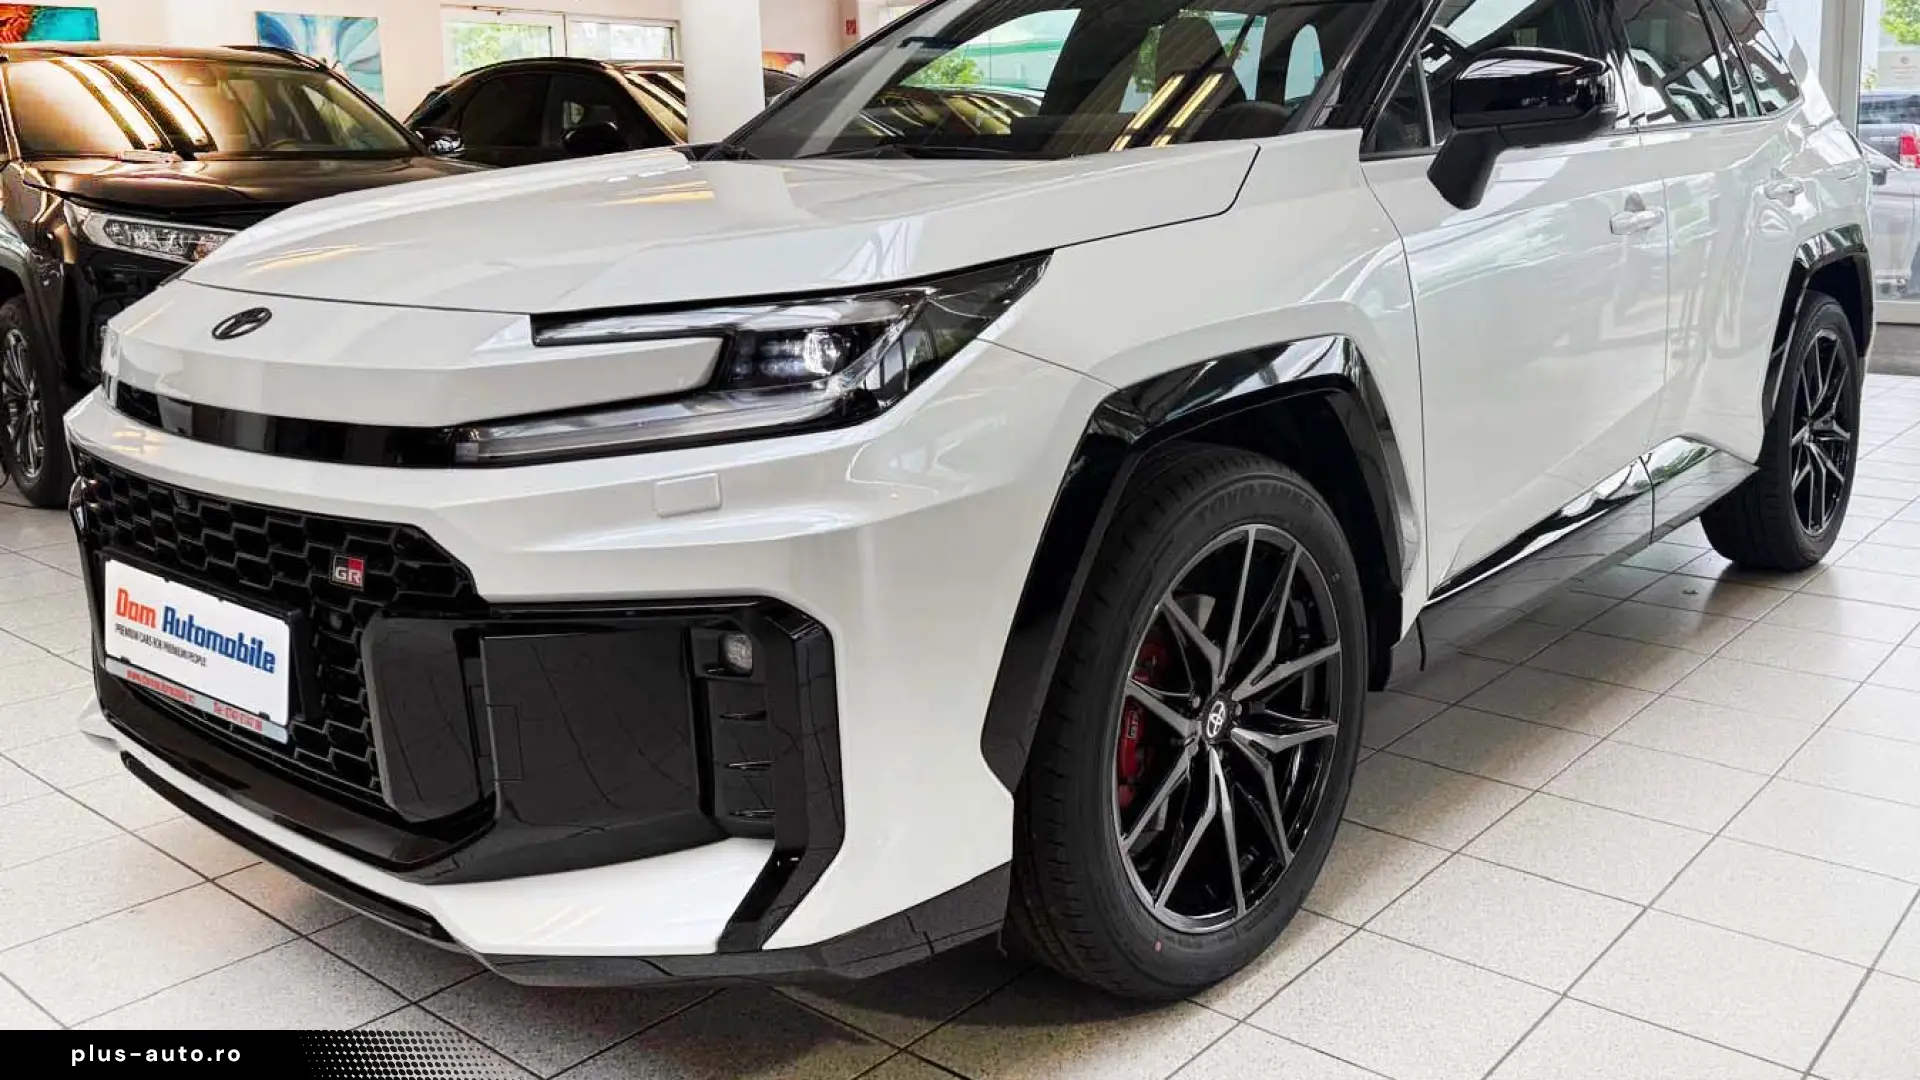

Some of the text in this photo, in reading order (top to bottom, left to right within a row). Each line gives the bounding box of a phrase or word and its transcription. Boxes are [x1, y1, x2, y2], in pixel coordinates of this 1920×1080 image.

[335, 566, 363, 585] GR
[115, 587, 276, 674] Dom Automobile
